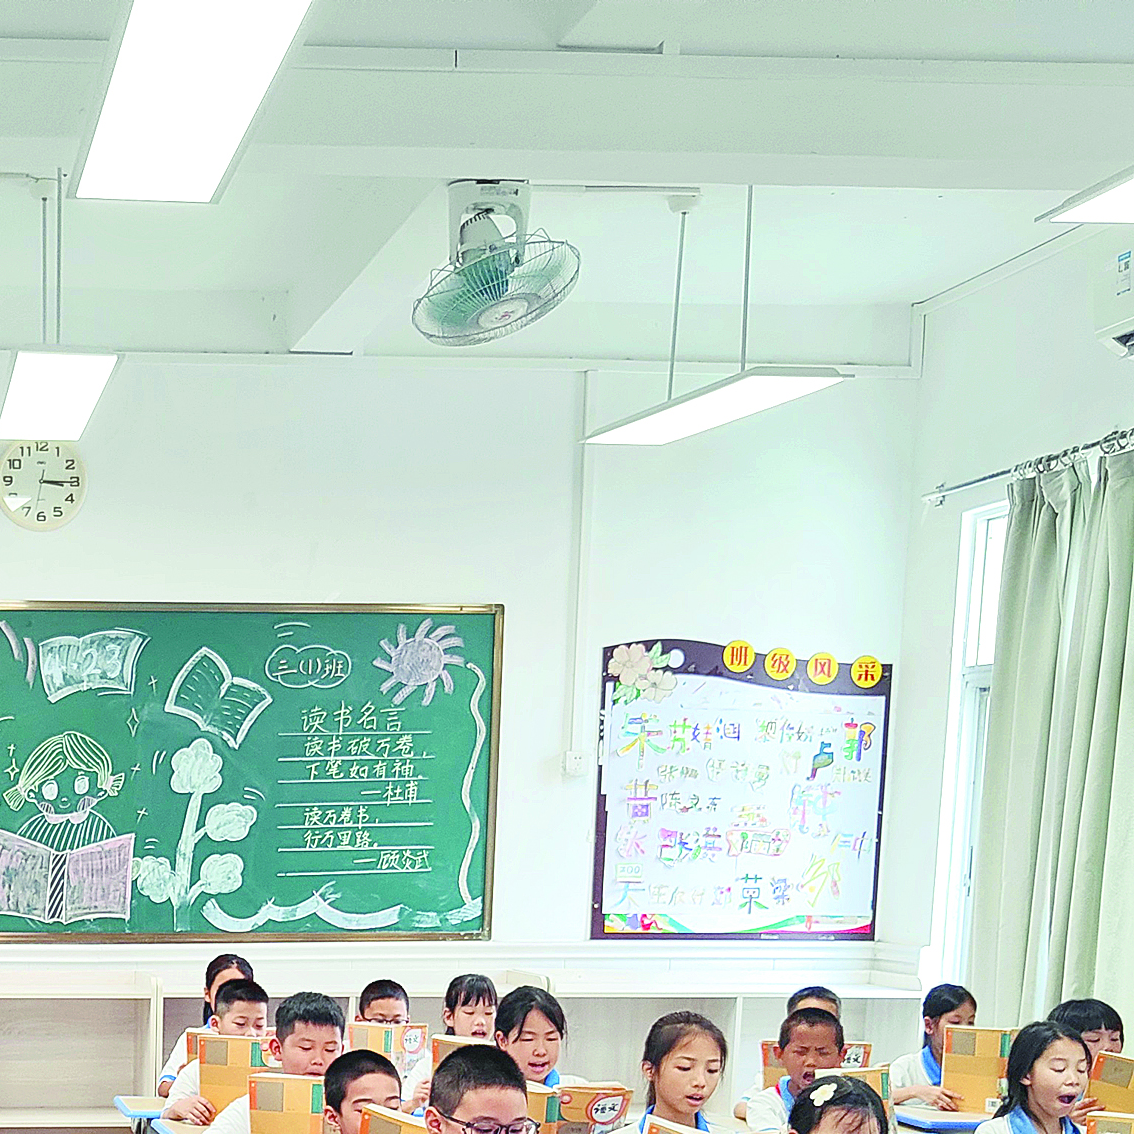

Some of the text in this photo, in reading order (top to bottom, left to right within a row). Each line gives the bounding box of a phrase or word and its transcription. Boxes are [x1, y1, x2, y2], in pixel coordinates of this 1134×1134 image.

[19, 446, 32, 457] 11
[35, 442, 49, 452] 12
[55, 446, 60, 457] 1
[7, 459, 22, 470] 10
[65, 459, 76, 470] 2
[3, 475, 13, 486] 9
[70, 476, 80, 487] 3
[64, 493, 75, 504] 4
[22, 506, 32, 517] 7
[36, 511, 46, 522] 6
[53, 506, 63, 517] 5
[729, 646, 877, 682] 班级风采
[301, 700, 406, 735] 读书名言
[593, 1103, 619, 1115] 语文
